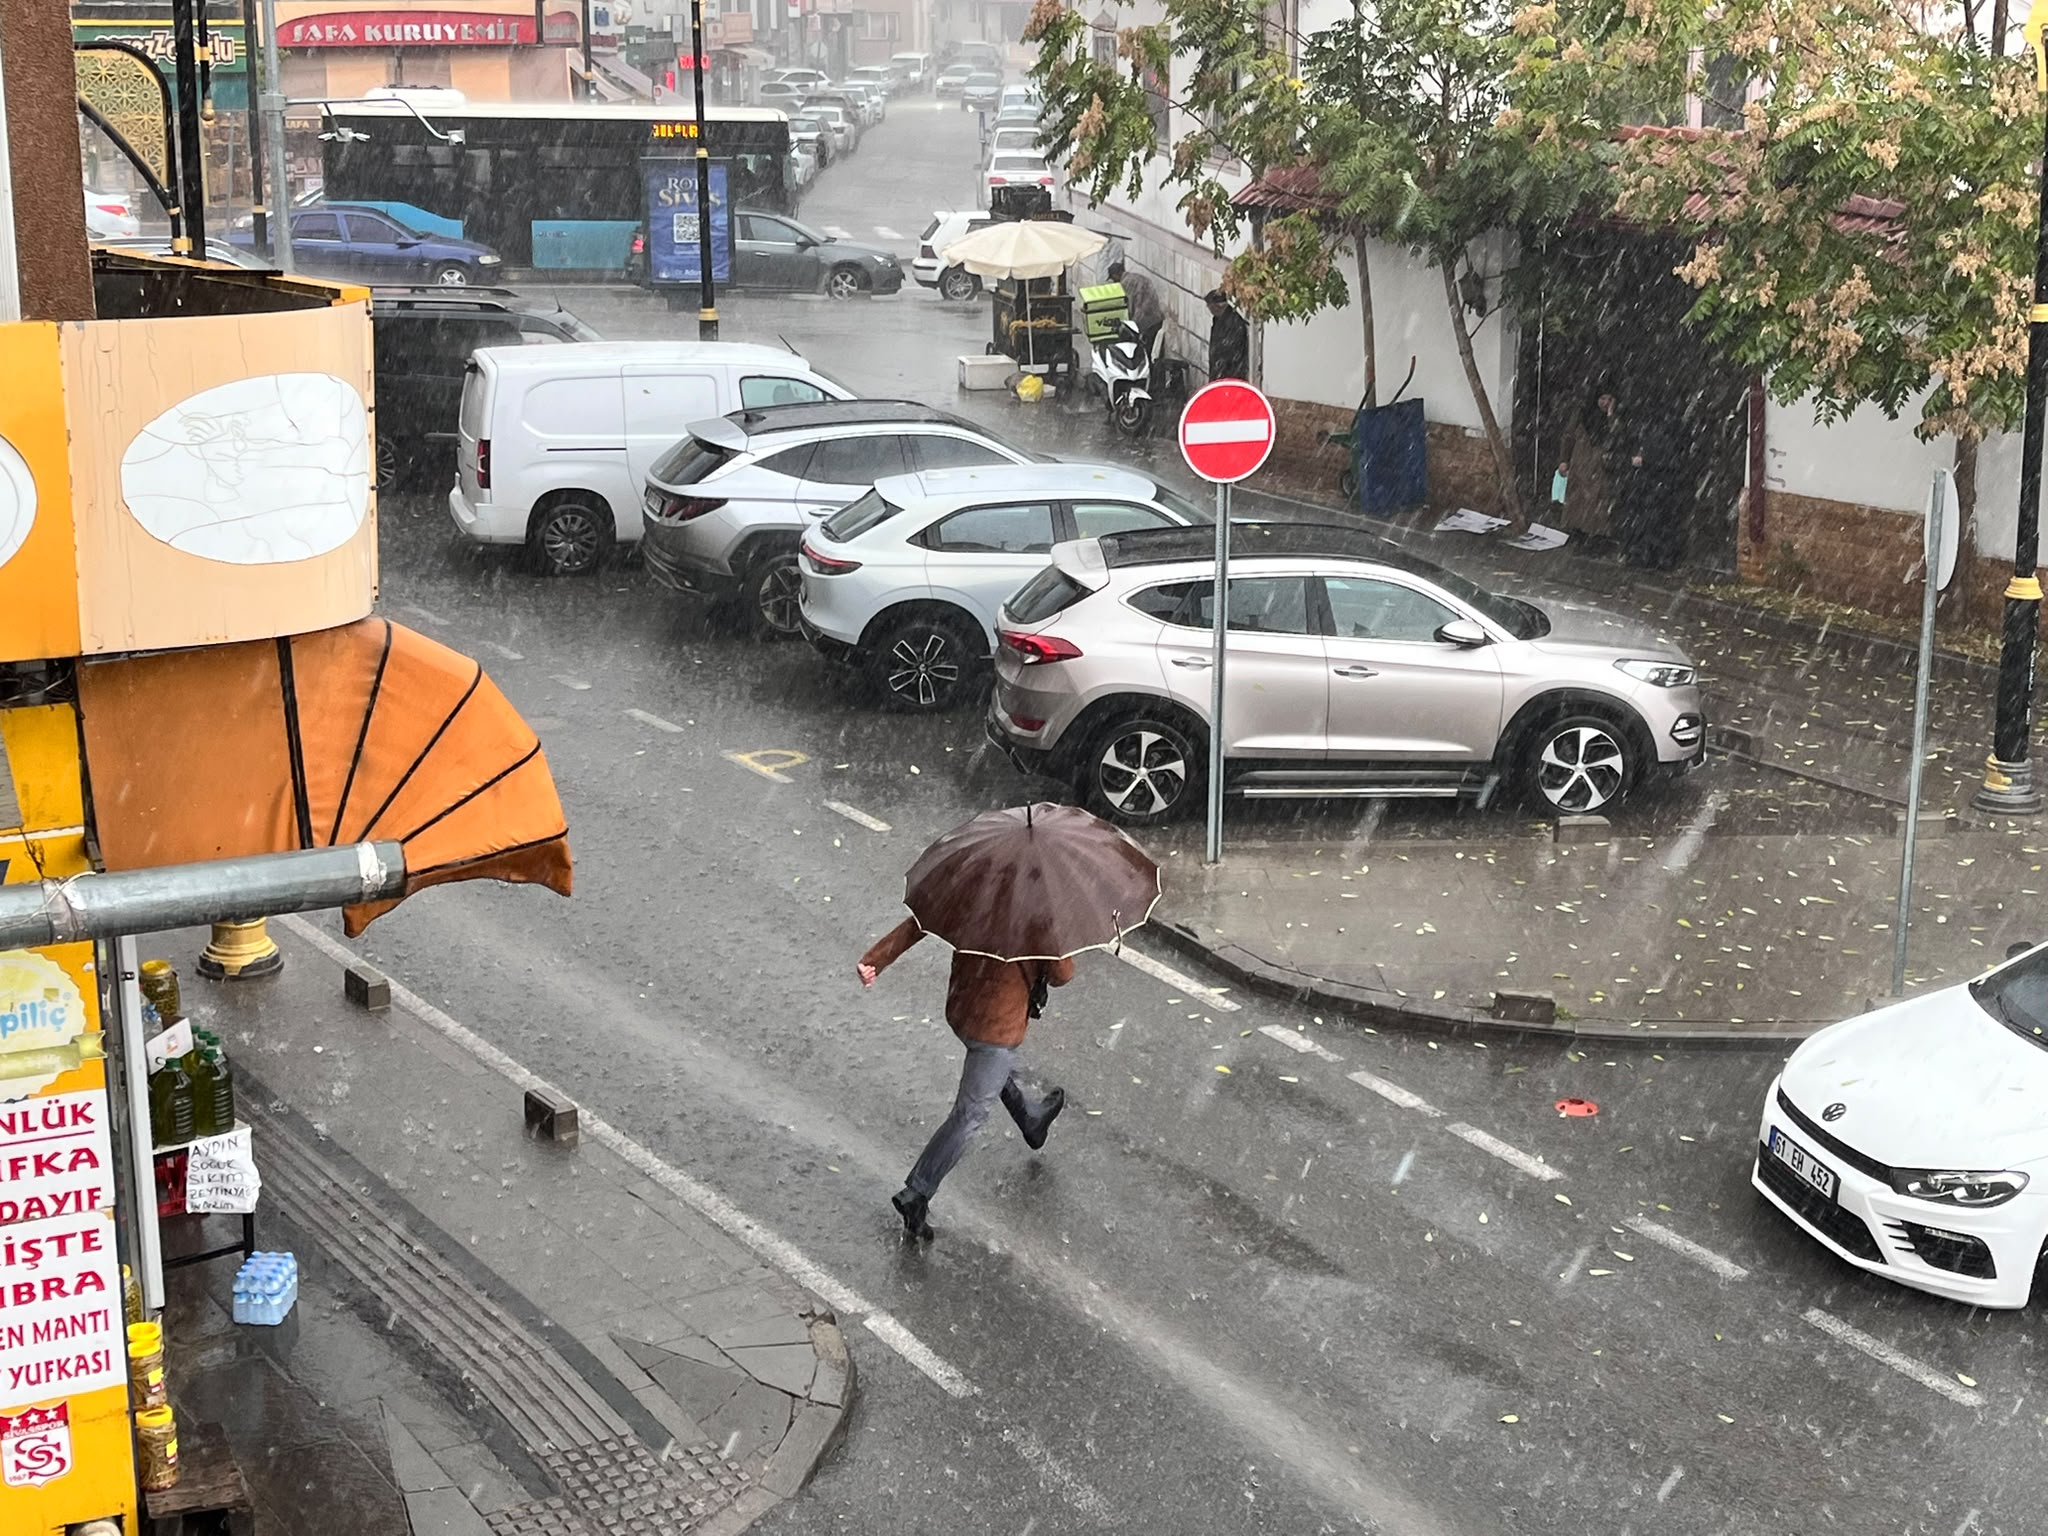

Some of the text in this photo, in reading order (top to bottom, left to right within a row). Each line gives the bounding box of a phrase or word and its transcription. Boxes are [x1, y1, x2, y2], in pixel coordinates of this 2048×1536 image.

[292, 23, 356, 42] SAFA
[365, 18, 520, 44] KURUYEMİŞ
[0, 1148, 99, 1183] FKA
[1776, 1136, 1829, 1193] 61 EH 452
[32, 1308, 110, 1345] MANTI
[8, 1349, 112, 1390] YUFKASI
